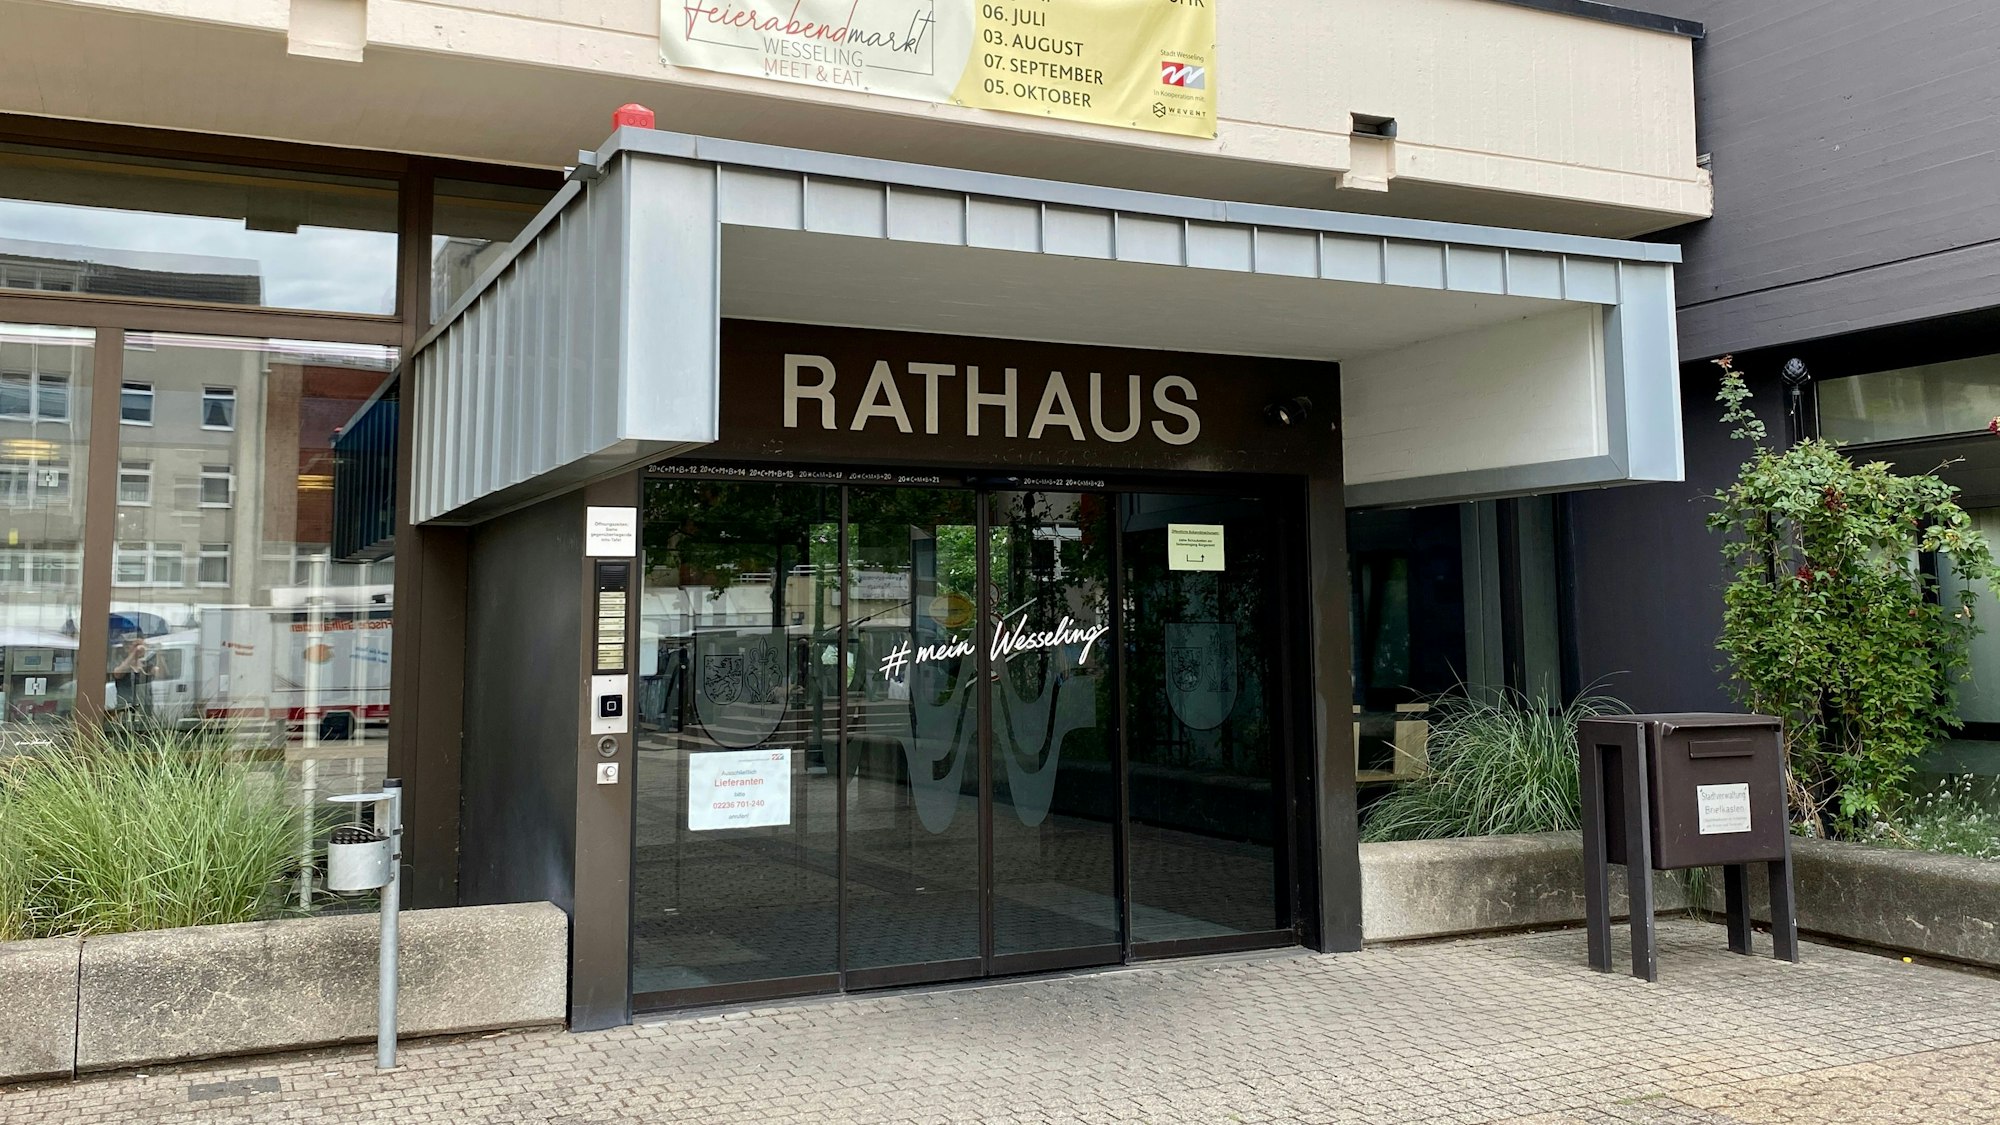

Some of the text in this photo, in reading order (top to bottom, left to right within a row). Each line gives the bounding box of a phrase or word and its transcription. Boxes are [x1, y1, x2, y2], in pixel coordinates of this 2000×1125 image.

[684, 0, 936, 54] feierabendmarkt
[983, 4, 1045, 27] 06. JULI
[763, 37, 863, 67] WESSELING
[983, 29, 1084, 57] 03. AUGUST
[764, 57, 863, 86] MEET & EAT
[984, 53, 1103, 85] 07. SEPTEMBER
[984, 78, 1092, 108] 05. OKTOBER
[783, 353, 1201, 446] RATHAUS
[990, 613, 1109, 665] Wesseling
[714, 778, 764, 787] Lieferanten
[736, 799, 765, 808] 701-240
